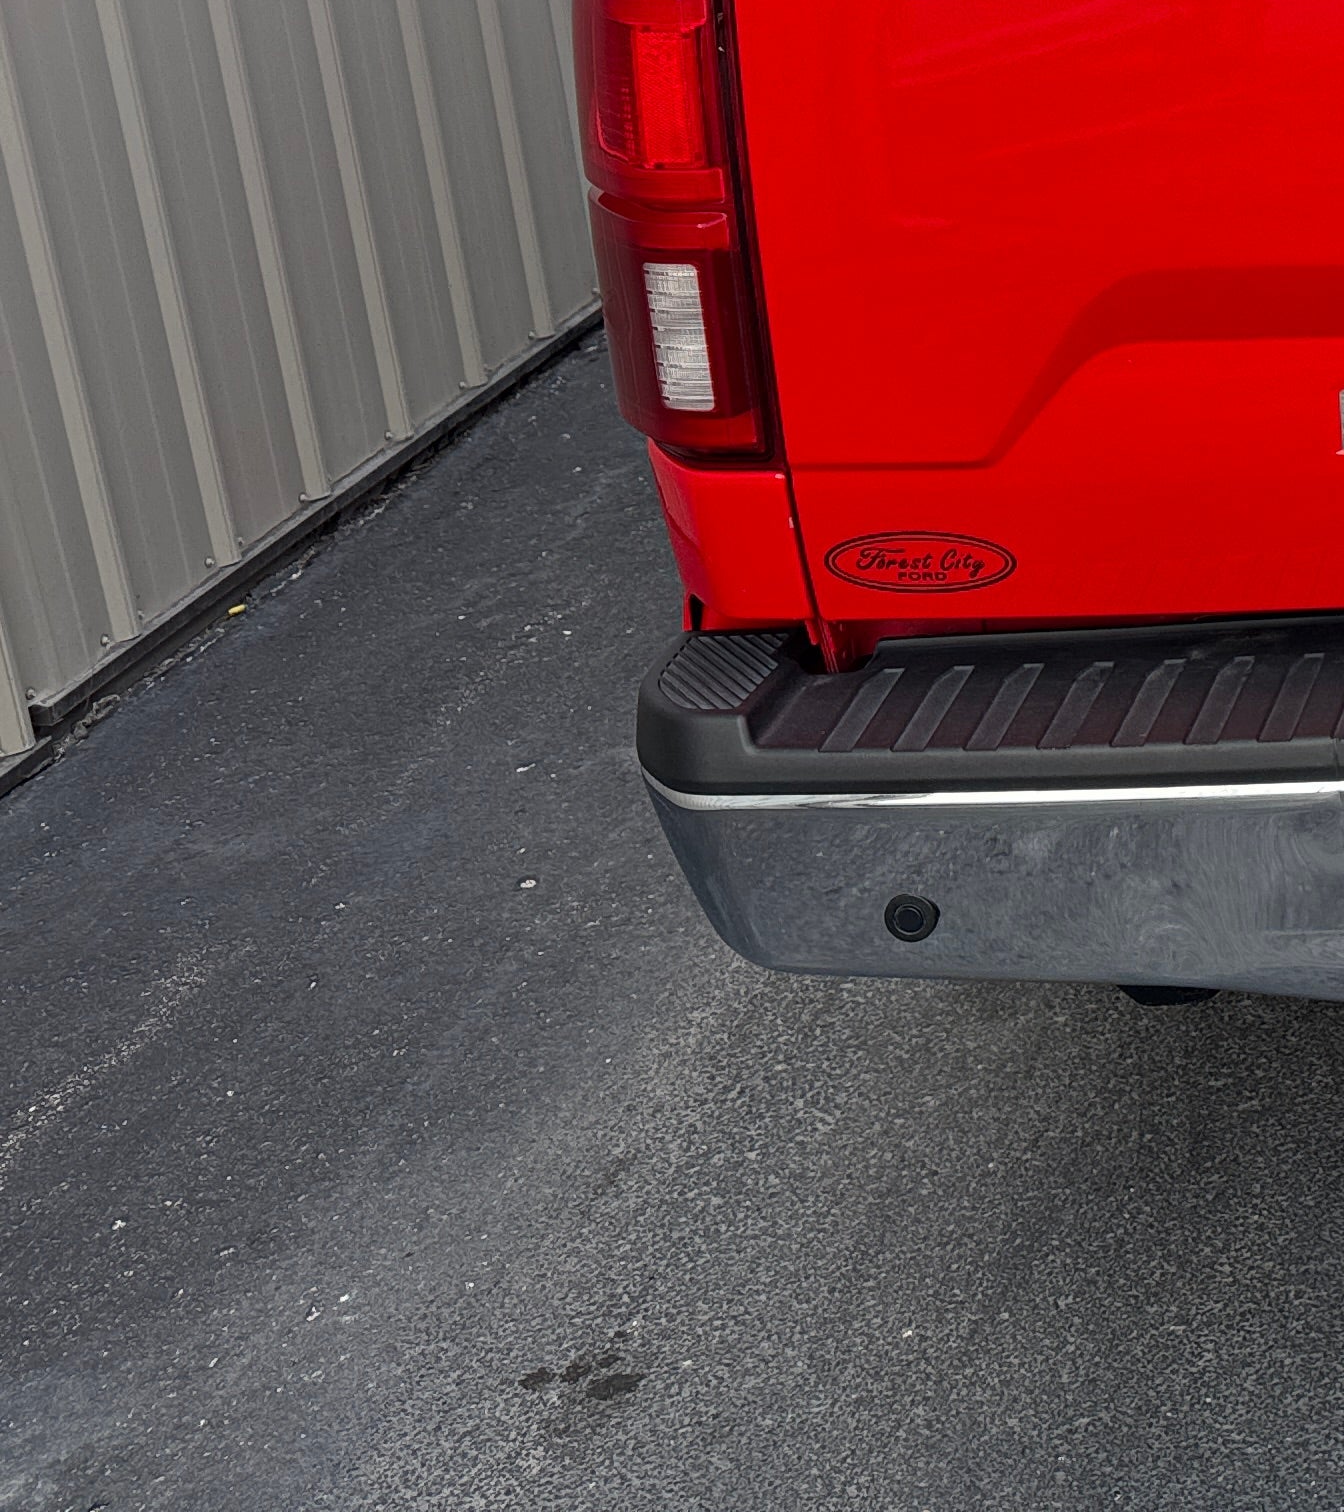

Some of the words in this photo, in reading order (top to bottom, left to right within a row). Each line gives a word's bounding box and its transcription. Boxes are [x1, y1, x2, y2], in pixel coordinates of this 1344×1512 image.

[856, 547, 933, 571] Forest
[940, 548, 985, 579] City
[898, 571, 947, 581] FORD
